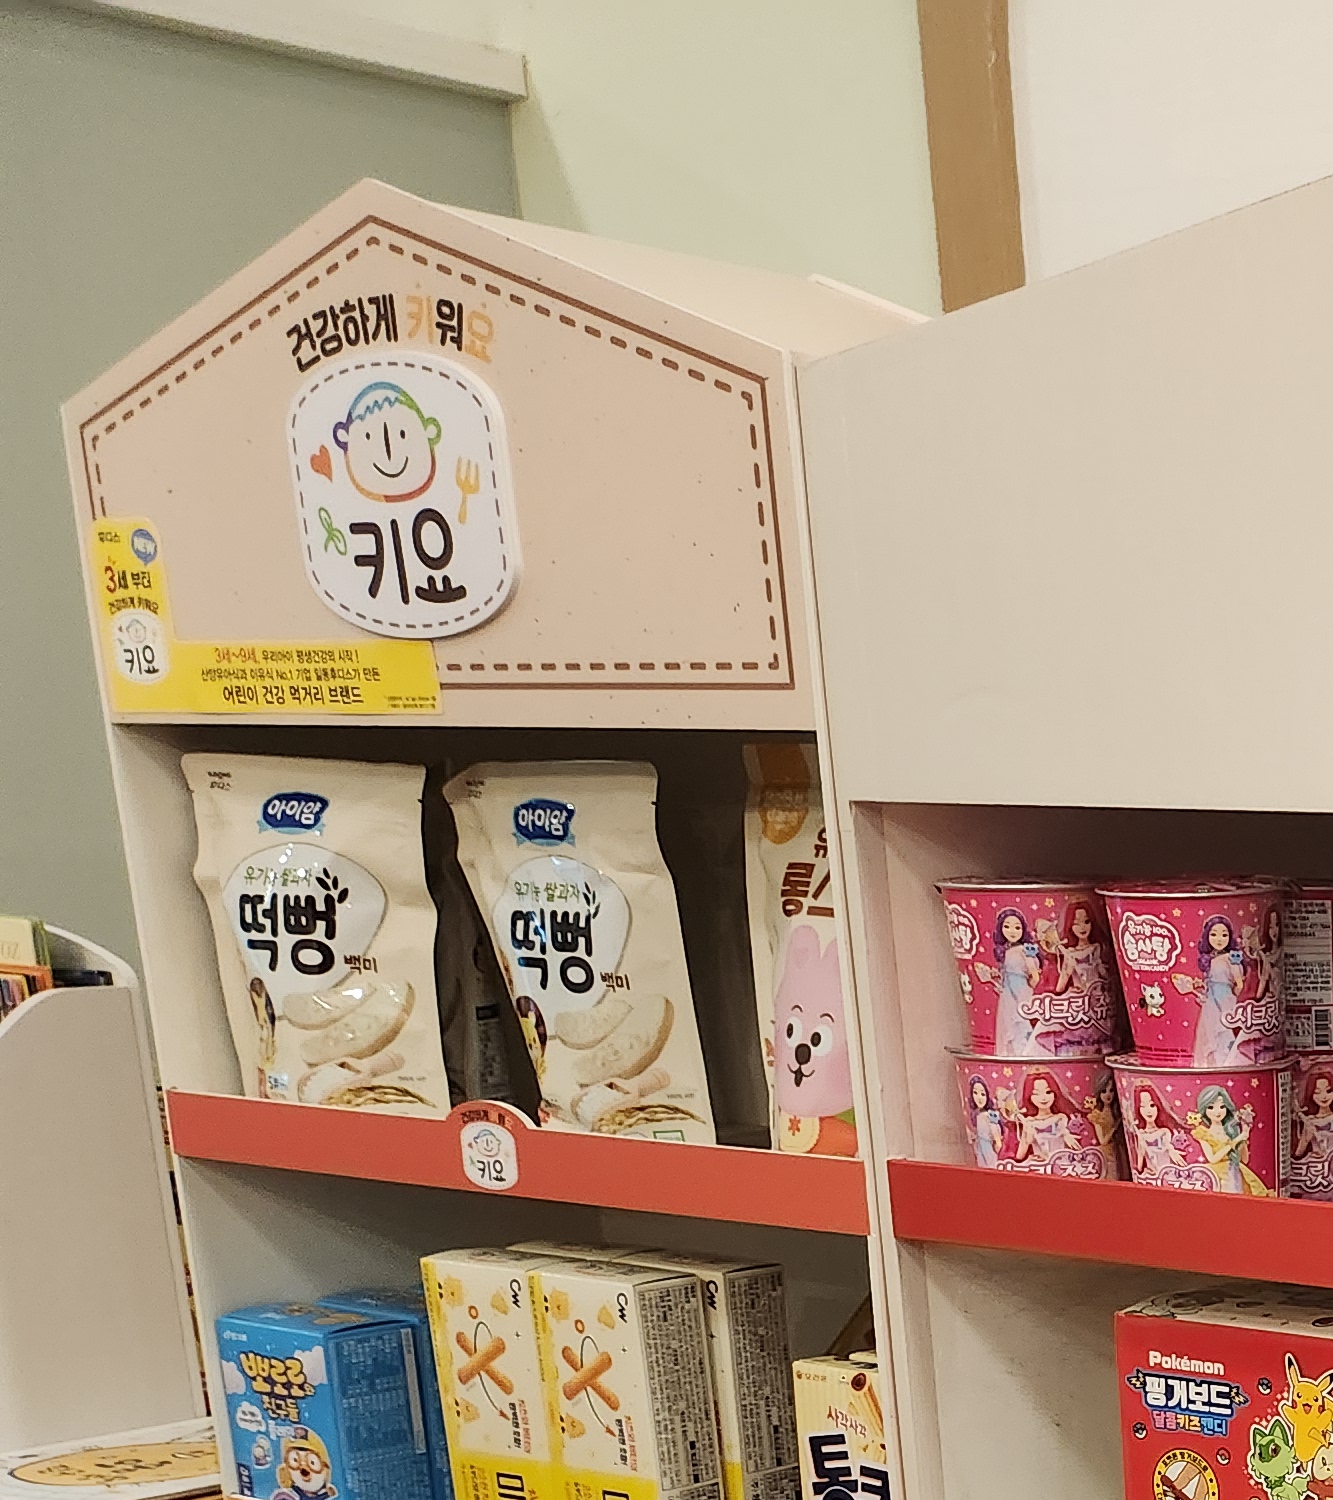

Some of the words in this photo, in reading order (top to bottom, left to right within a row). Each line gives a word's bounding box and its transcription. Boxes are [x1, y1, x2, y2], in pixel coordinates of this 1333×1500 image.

[286, 293, 398, 372] 건강하게
[405, 295, 497, 364] 키워요
[349, 507, 469, 606] 키요
[131, 570, 153, 589] 부터
[123, 644, 160, 675] 키요
[222, 685, 259, 706] 어린이
[262, 685, 286, 705] 건강
[289, 685, 325, 706] 먹거리
[328, 685, 364, 705] 브랜드
[266, 798, 323, 826] 아이얌
[517, 807, 569, 837] 아이얌
[543, 880, 581, 903] 쌀과자
[238, 892, 337, 976] 떡뻥
[343, 953, 379, 975] 백미
[510, 907, 595, 994] 떡뻥
[600, 971, 632, 994] 백미
[476, 1159, 506, 1184] 키요
[1148, 1350, 1225, 1376] Pokémon
[1145, 1376, 1232, 1415] 핑거보드
[826, 1404, 868, 1438] 사각사각
